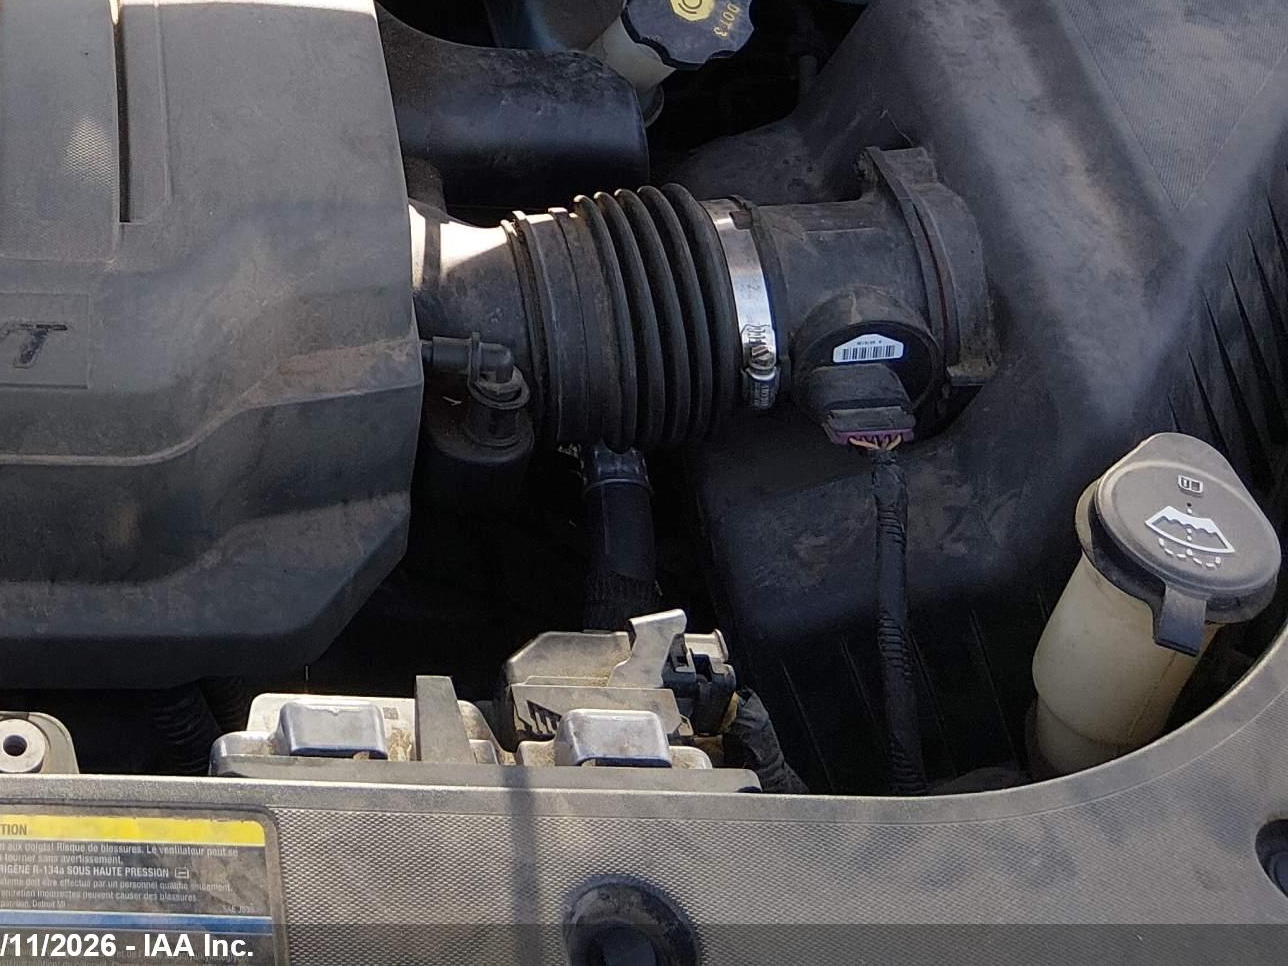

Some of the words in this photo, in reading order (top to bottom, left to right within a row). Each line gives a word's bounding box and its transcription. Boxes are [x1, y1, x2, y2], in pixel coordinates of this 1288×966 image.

[712, 25, 729, 39] 3
[8, 843, 22, 851] aux
[56, 842, 86, 852] Risque
[88, 844, 98, 852] de
[146, 845, 158, 854] Le
[160, 846, 205, 856] ventilateur
[6, 853, 36, 862] tourner
[38, 854, 58, 863] sans
[32, 864, 65, 875] R-134a
[66, 866, 91, 876] SOUS
[93, 866, 122, 876] HAUTE
[124, 867, 169, 878] PRESSION
[93, 880, 106, 890] par
[120, 881, 158, 891] personnel
[82, 892, 114, 901] peuvent
[115, 892, 142, 900] causer
[144, 892, 157, 900] des
